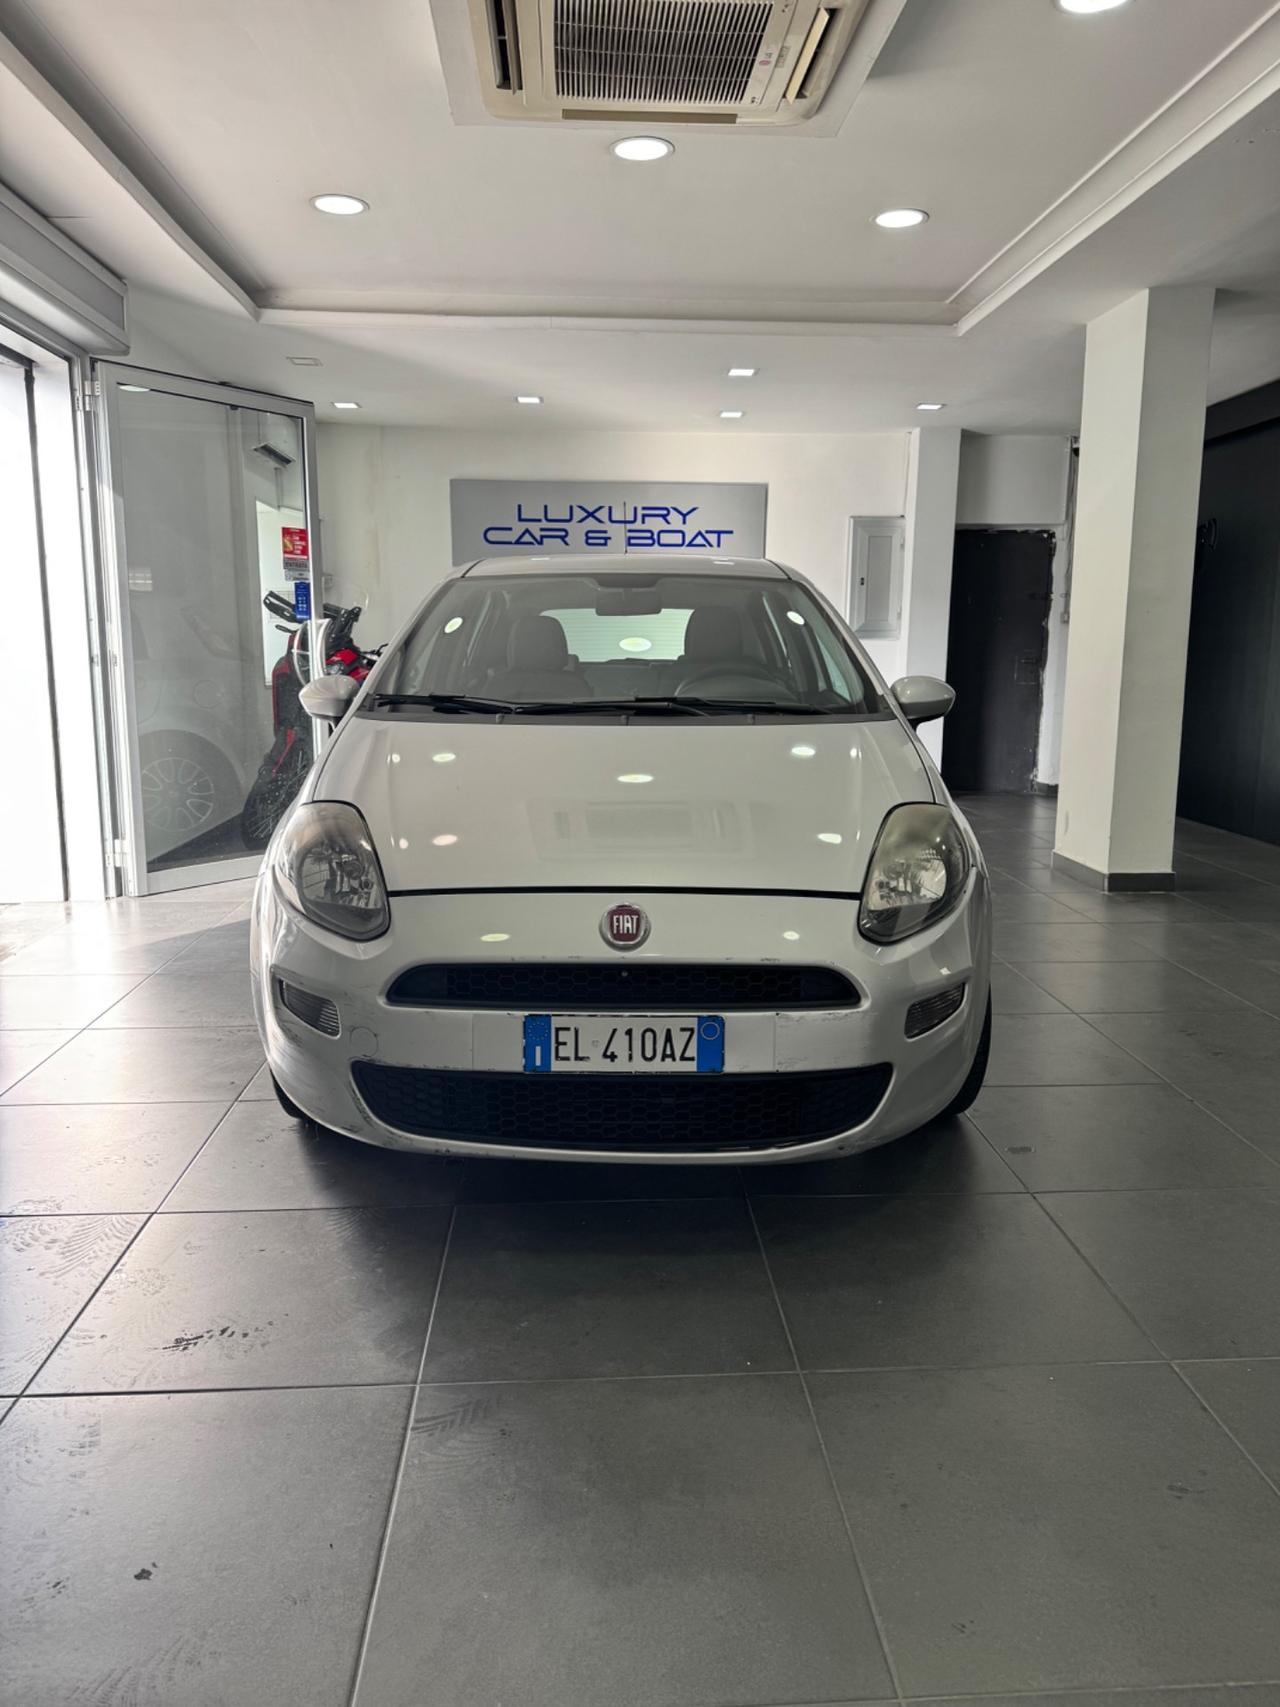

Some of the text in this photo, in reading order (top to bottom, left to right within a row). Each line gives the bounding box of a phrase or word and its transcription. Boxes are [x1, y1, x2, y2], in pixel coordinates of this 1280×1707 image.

[517, 503, 698, 525] LUXURY
[483, 527, 734, 548] CAR & BOAT
[613, 915, 639, 934] FIAT
[554, 1027, 696, 1063] EL 410AZ
